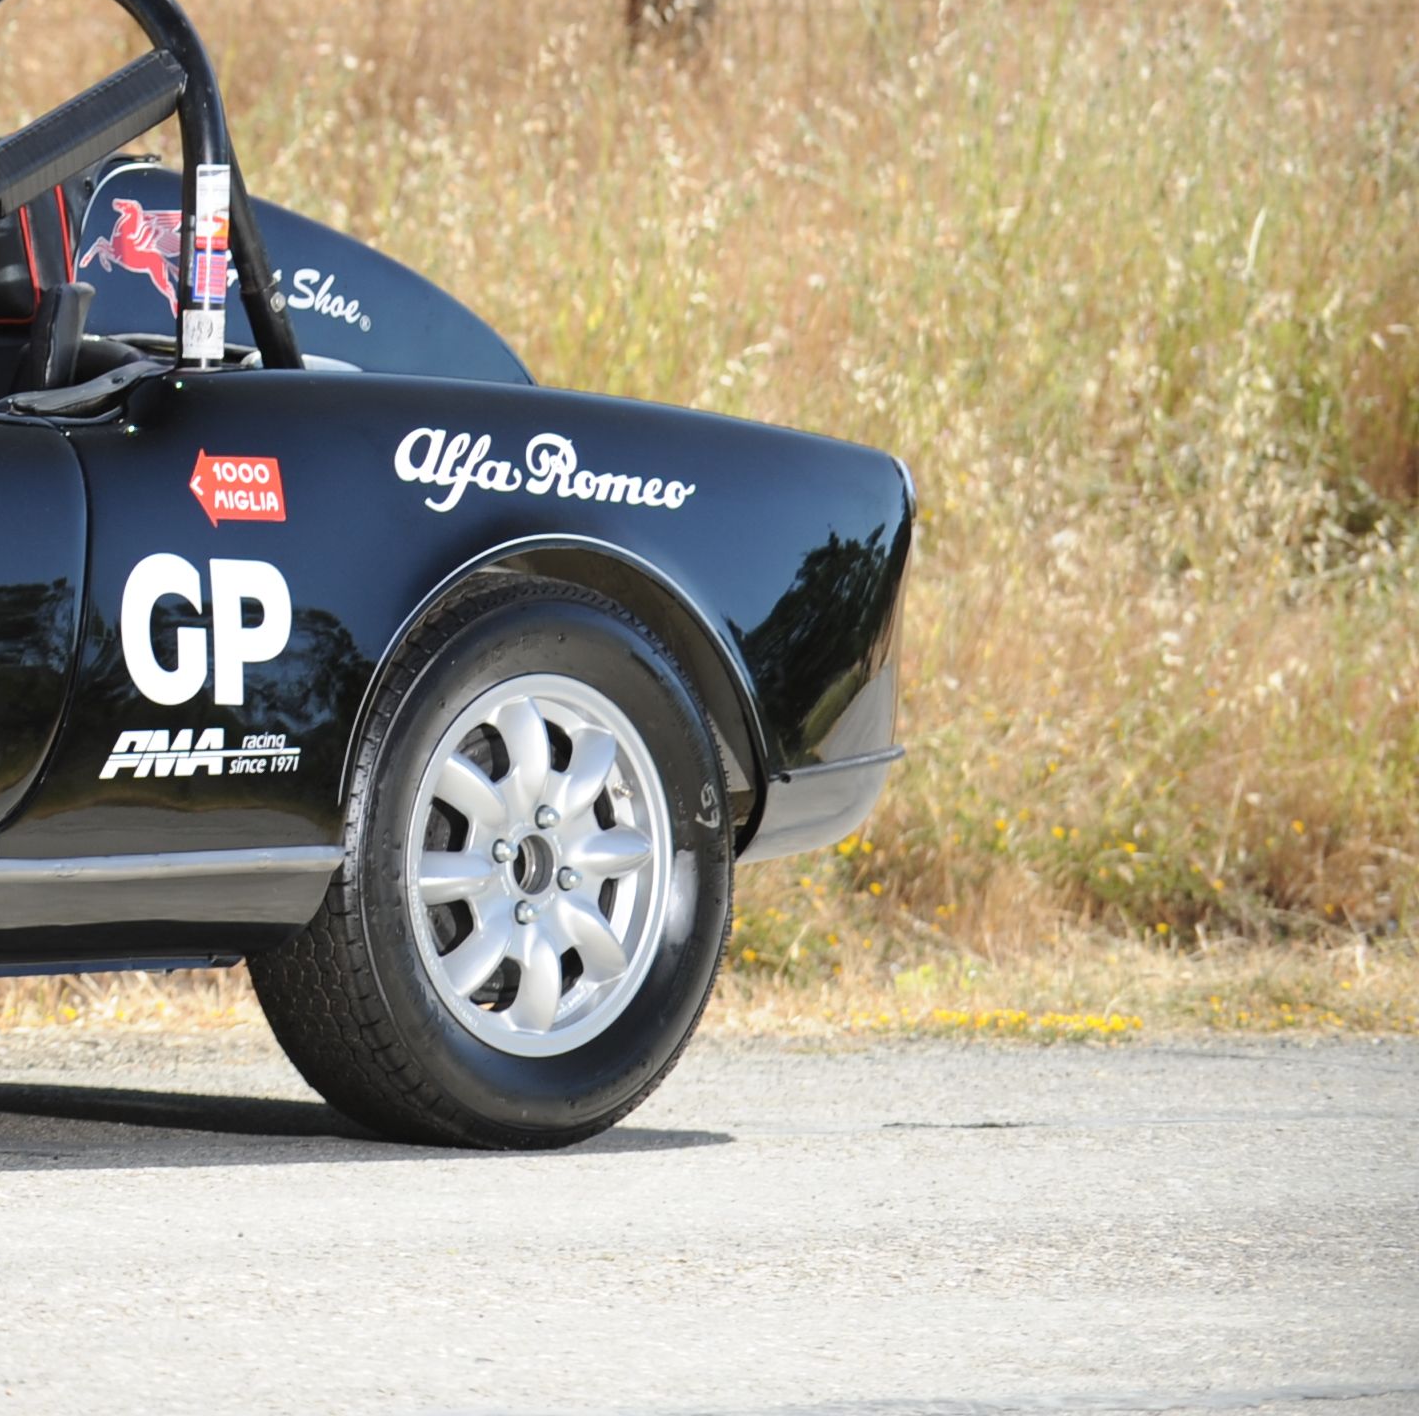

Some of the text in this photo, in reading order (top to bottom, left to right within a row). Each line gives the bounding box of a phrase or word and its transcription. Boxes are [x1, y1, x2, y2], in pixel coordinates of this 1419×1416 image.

[287, 268, 361, 324] Shoe
[211, 462, 271, 486] 1000
[394, 427, 696, 513] Alfa Romeo
[212, 488, 280, 514] MIGLIA
[120, 552, 293, 706] GP
[241, 732, 287, 752] racing
[228, 754, 300, 775] since 1971
